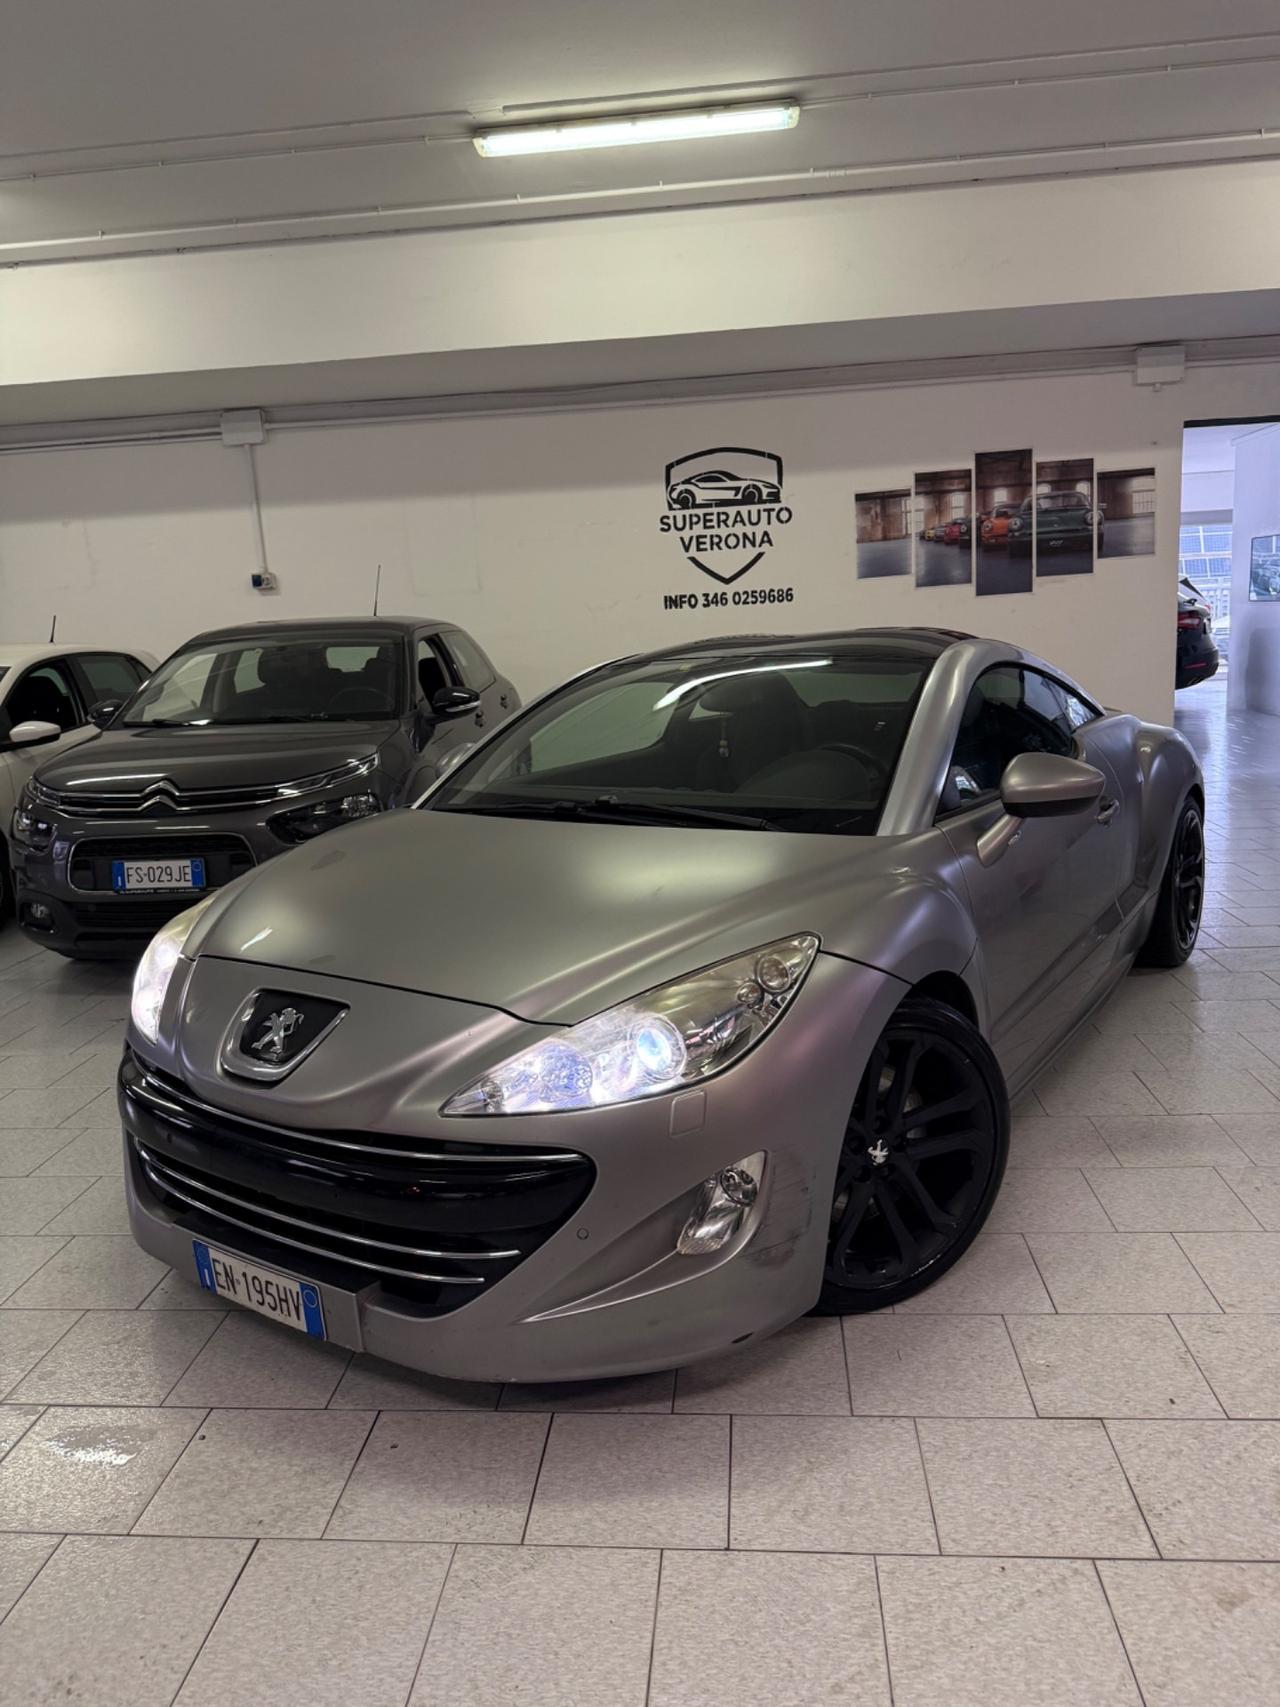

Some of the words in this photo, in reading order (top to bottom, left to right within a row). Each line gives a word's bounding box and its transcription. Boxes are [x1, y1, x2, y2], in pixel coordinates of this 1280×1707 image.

[659, 506, 793, 533] SUPERAUTO
[680, 530, 773, 553] VERONA
[663, 593, 698, 610] INFO
[702, 591, 729, 608] 346
[732, 587, 794, 605] 0259686
